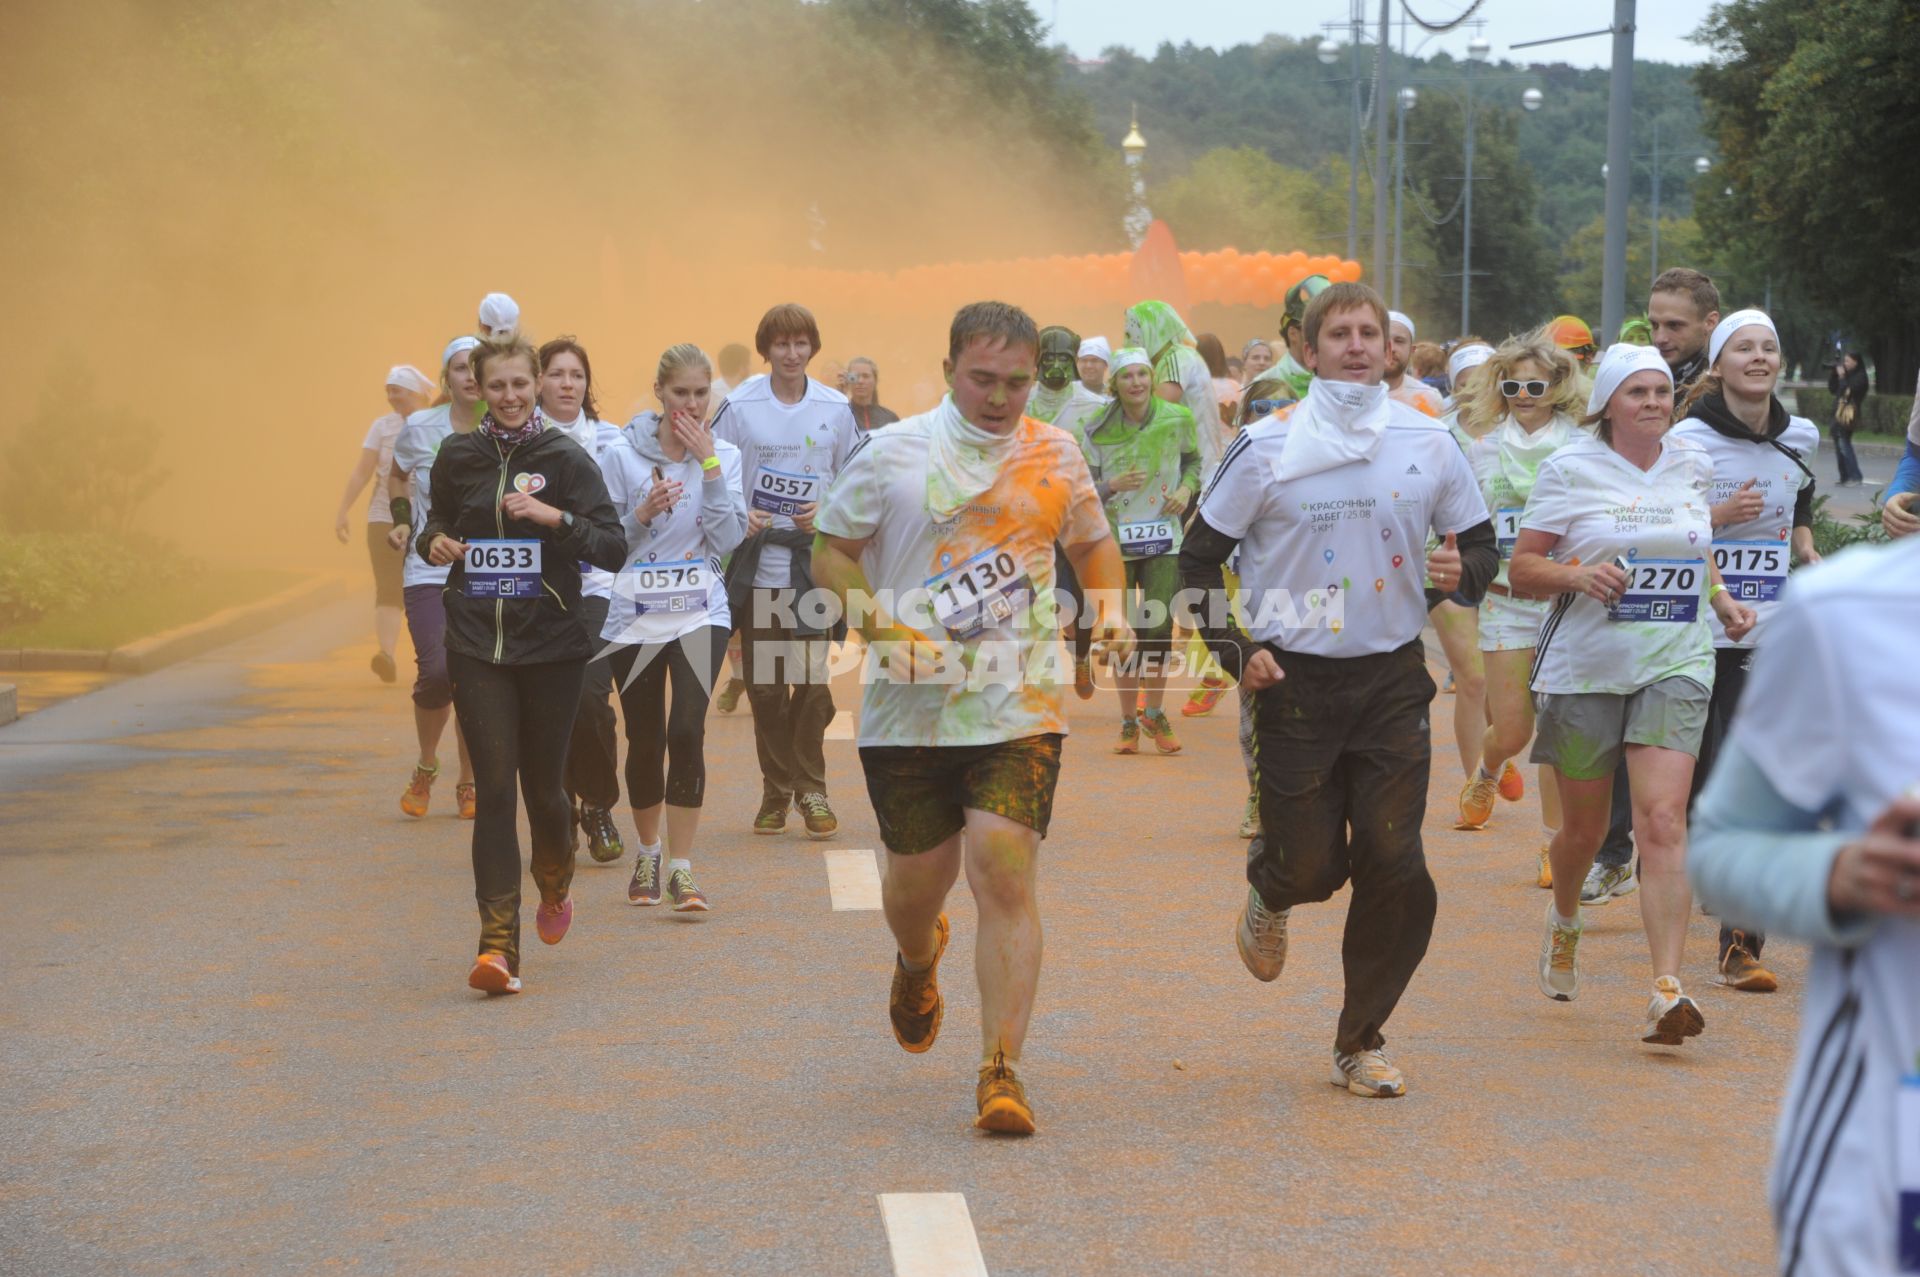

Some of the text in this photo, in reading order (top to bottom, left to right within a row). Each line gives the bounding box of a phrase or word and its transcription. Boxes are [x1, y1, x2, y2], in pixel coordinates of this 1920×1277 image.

[761, 474, 813, 497] 0557
[1716, 479, 1772, 490] КРАСОНЫЙ
[1310, 498, 1376, 512] КРАСОЧНЫЙ
[1613, 505, 1674, 515] КРАСОЧНЫЙ
[1311, 511, 1342, 523] ЗАБЕГ
[1615, 515, 1644, 523] ЗАБЕГ
[1124, 524, 1168, 540] 1276
[471, 547, 533, 568] 0633
[1713, 549, 1779, 571] 0175
[640, 567, 700, 589] 0576
[940, 553, 1016, 614] 1130
[1628, 568, 1695, 590] 1270
